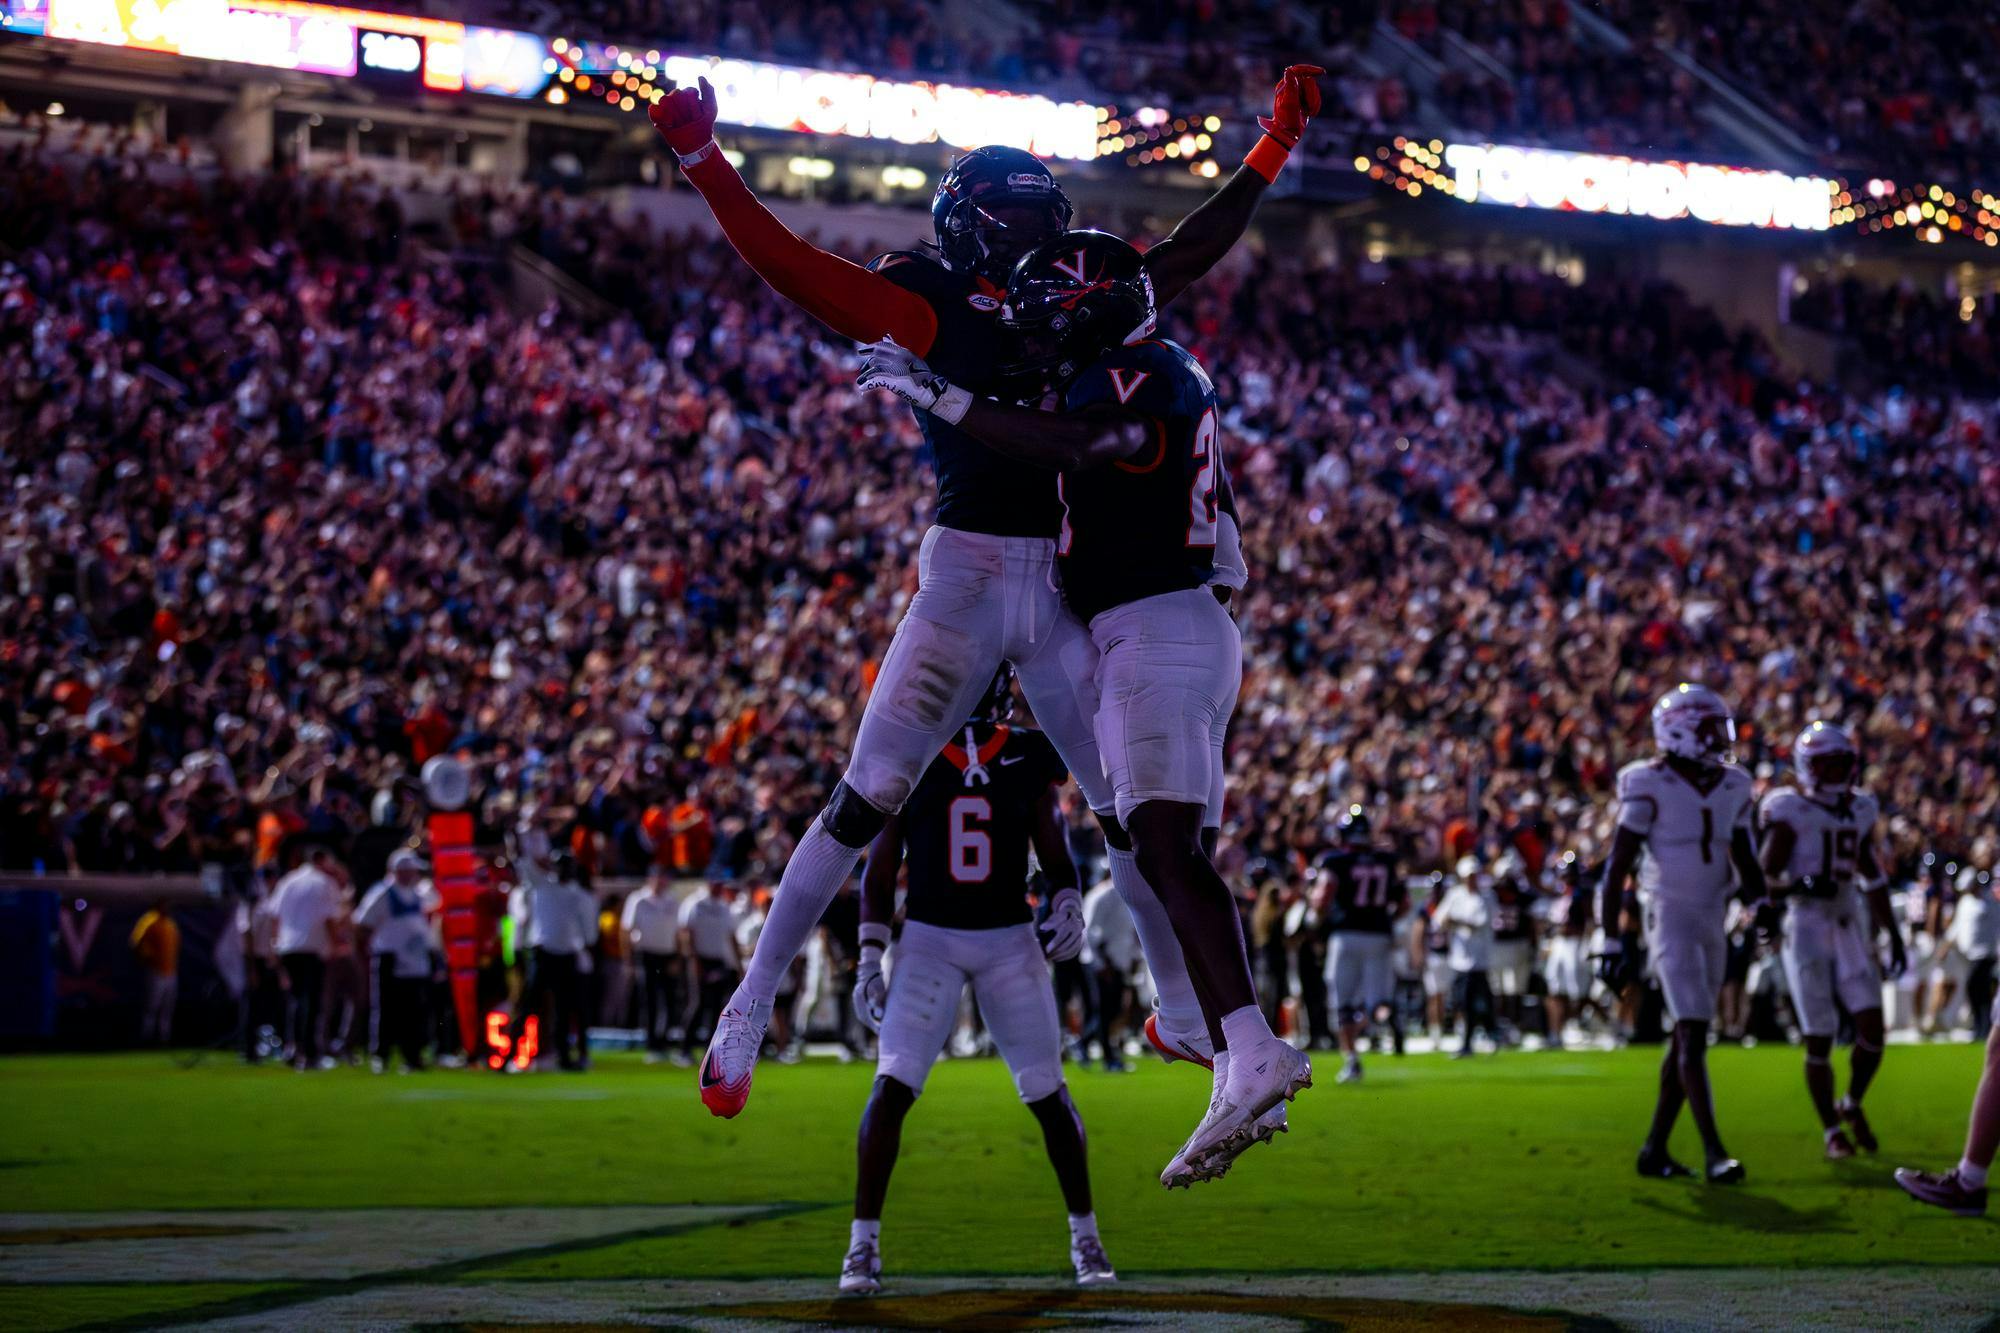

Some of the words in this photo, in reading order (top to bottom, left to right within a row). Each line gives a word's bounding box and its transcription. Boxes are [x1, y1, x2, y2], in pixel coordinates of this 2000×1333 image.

[1050, 247, 1087, 285] V
[972, 296, 997, 307] ACC
[1107, 368, 1152, 405] V
[946, 793, 994, 886] 6
[1701, 808, 1713, 865] 1
[1349, 863, 1390, 909] 77
